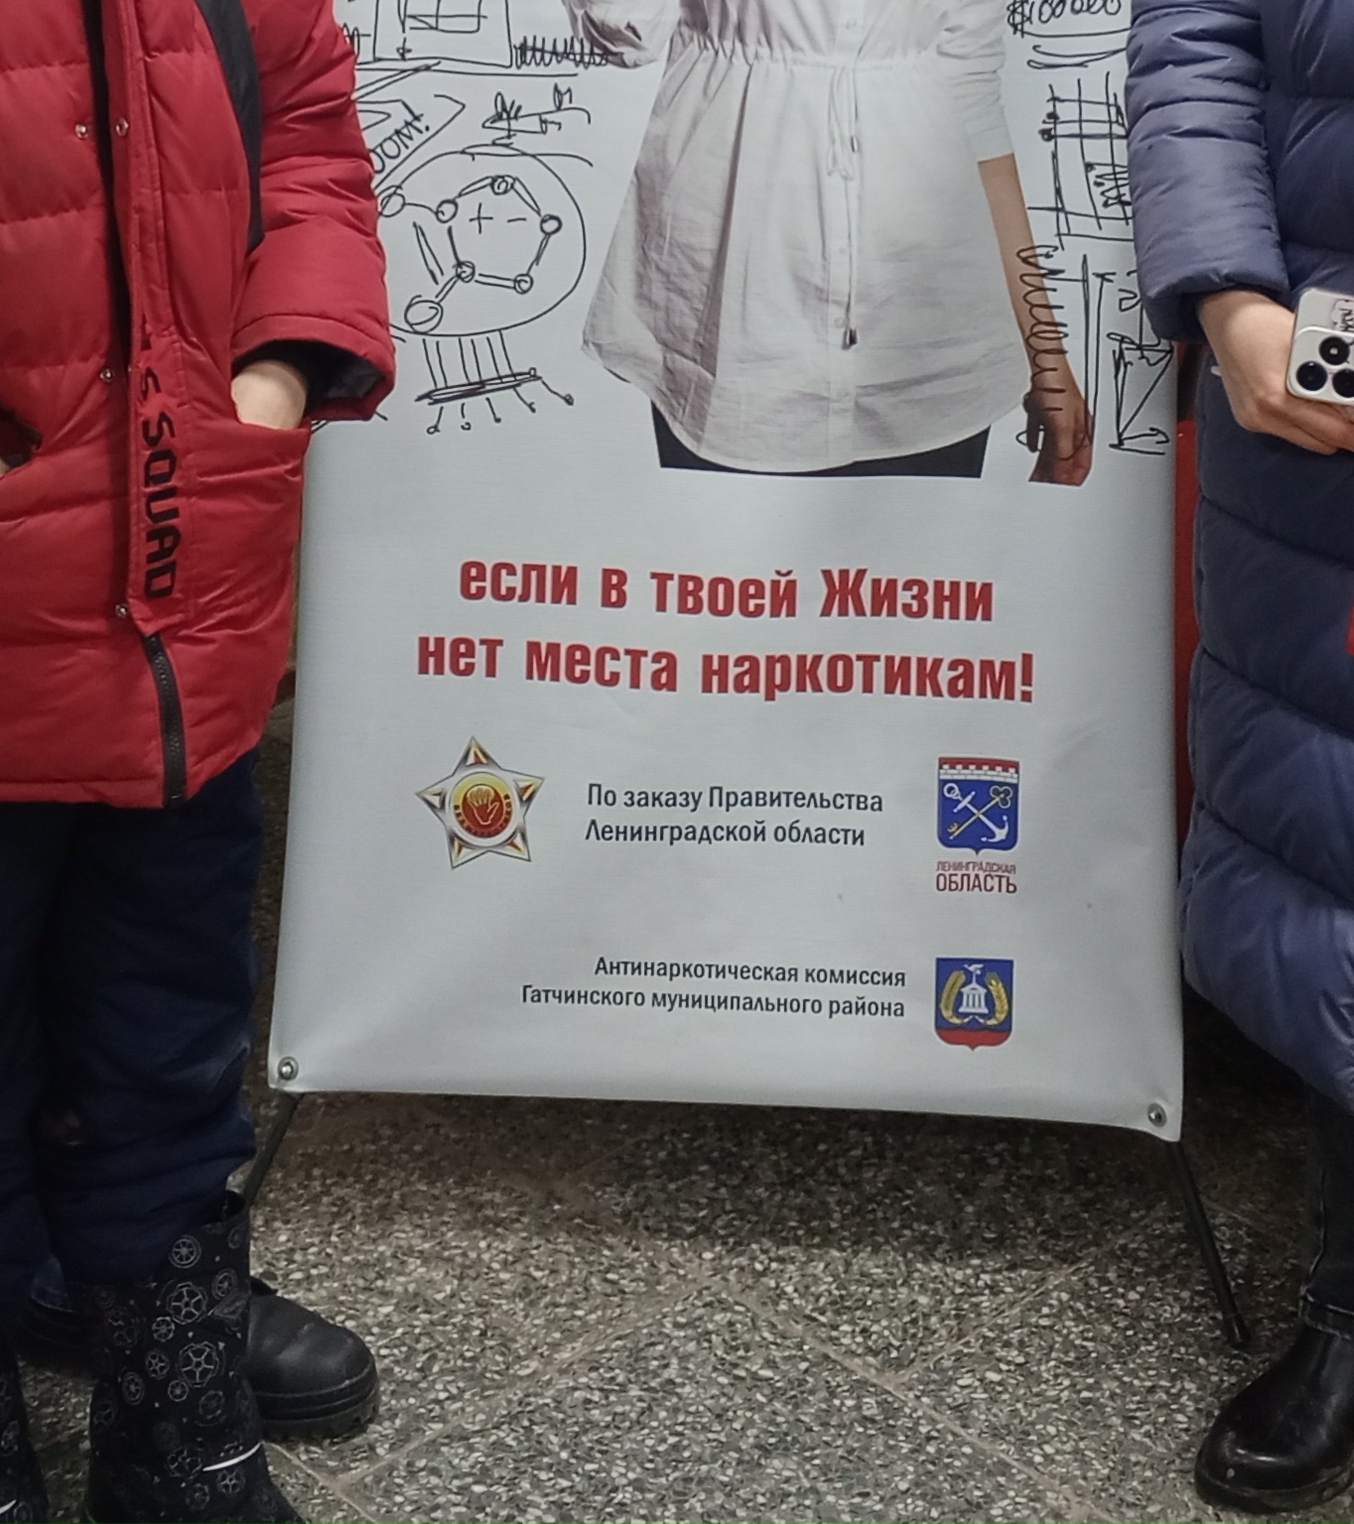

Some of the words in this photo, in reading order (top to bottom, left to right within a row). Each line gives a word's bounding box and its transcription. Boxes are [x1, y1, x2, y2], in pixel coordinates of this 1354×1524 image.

[141, 411, 182, 600] SQUAD
[459, 559, 579, 606] если
[600, 567, 628, 609] в
[649, 566, 798, 620] твоей
[821, 568, 994, 622] Жизни
[417, 633, 503, 679] нет
[525, 639, 679, 693] места
[700, 650, 1035, 703] наркотикам!
[587, 784, 615, 808] По
[622, 788, 703, 811] заказу
[708, 785, 884, 813] Правительства
[585, 819, 767, 847] Ленинградской
[773, 821, 866, 846] области
[937, 861, 1017, 875] ЛЕНИНГРАДСКАЯ
[936, 873, 1017, 894] ОБЛАСТЬ
[594, 957, 800, 984] Антинаркотическая
[805, 966, 907, 987] комиссия
[521, 986, 646, 1010] Гатчинского
[651, 992, 823, 1016] муниципального
[828, 998, 906, 1019] района
